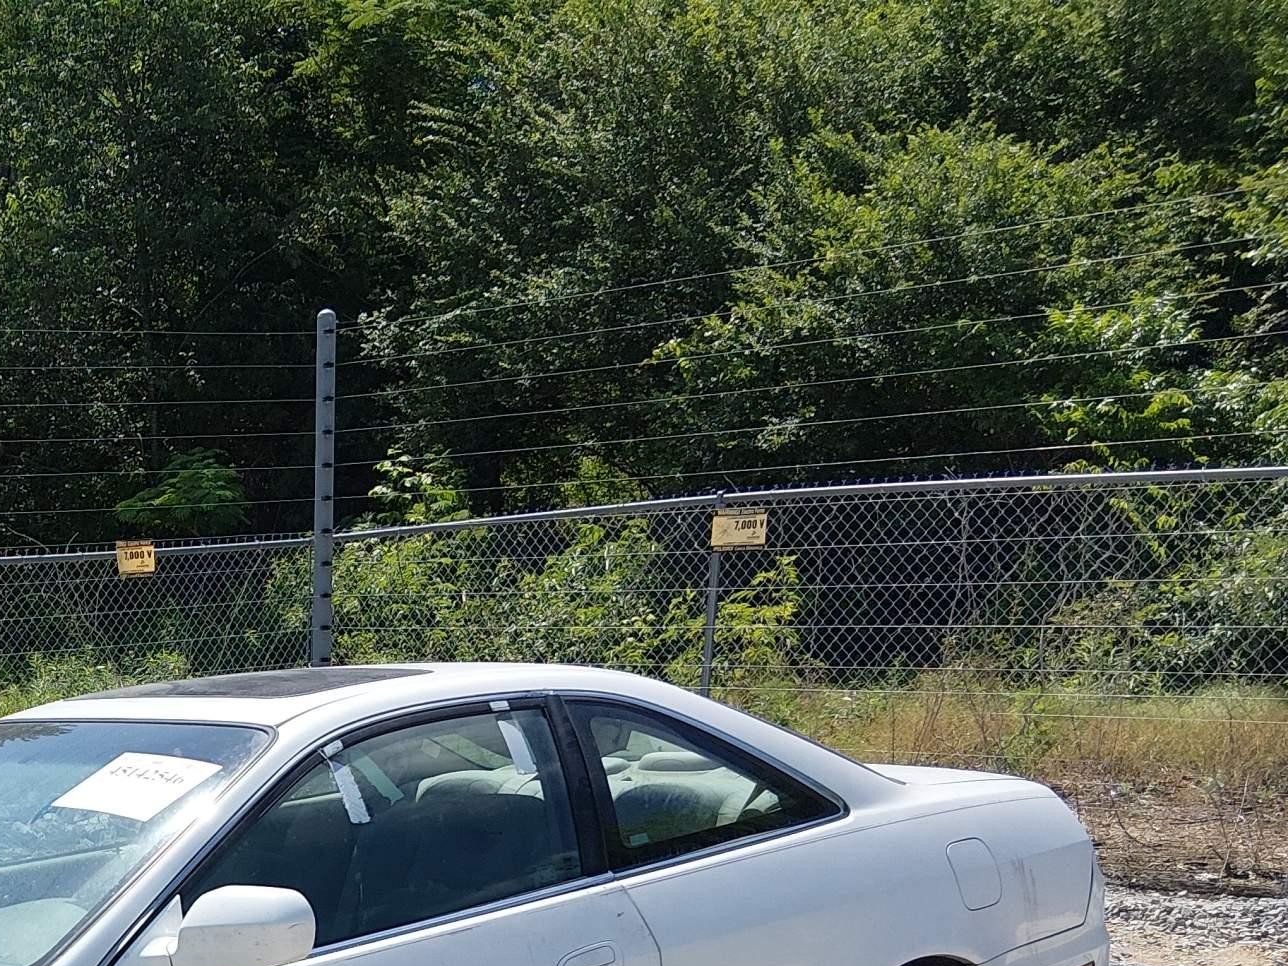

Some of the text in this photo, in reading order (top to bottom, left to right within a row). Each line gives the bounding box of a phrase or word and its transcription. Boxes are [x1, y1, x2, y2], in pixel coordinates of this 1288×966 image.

[734, 519, 765, 531] 7,000 V
[124, 550, 152, 561] 7,000 V
